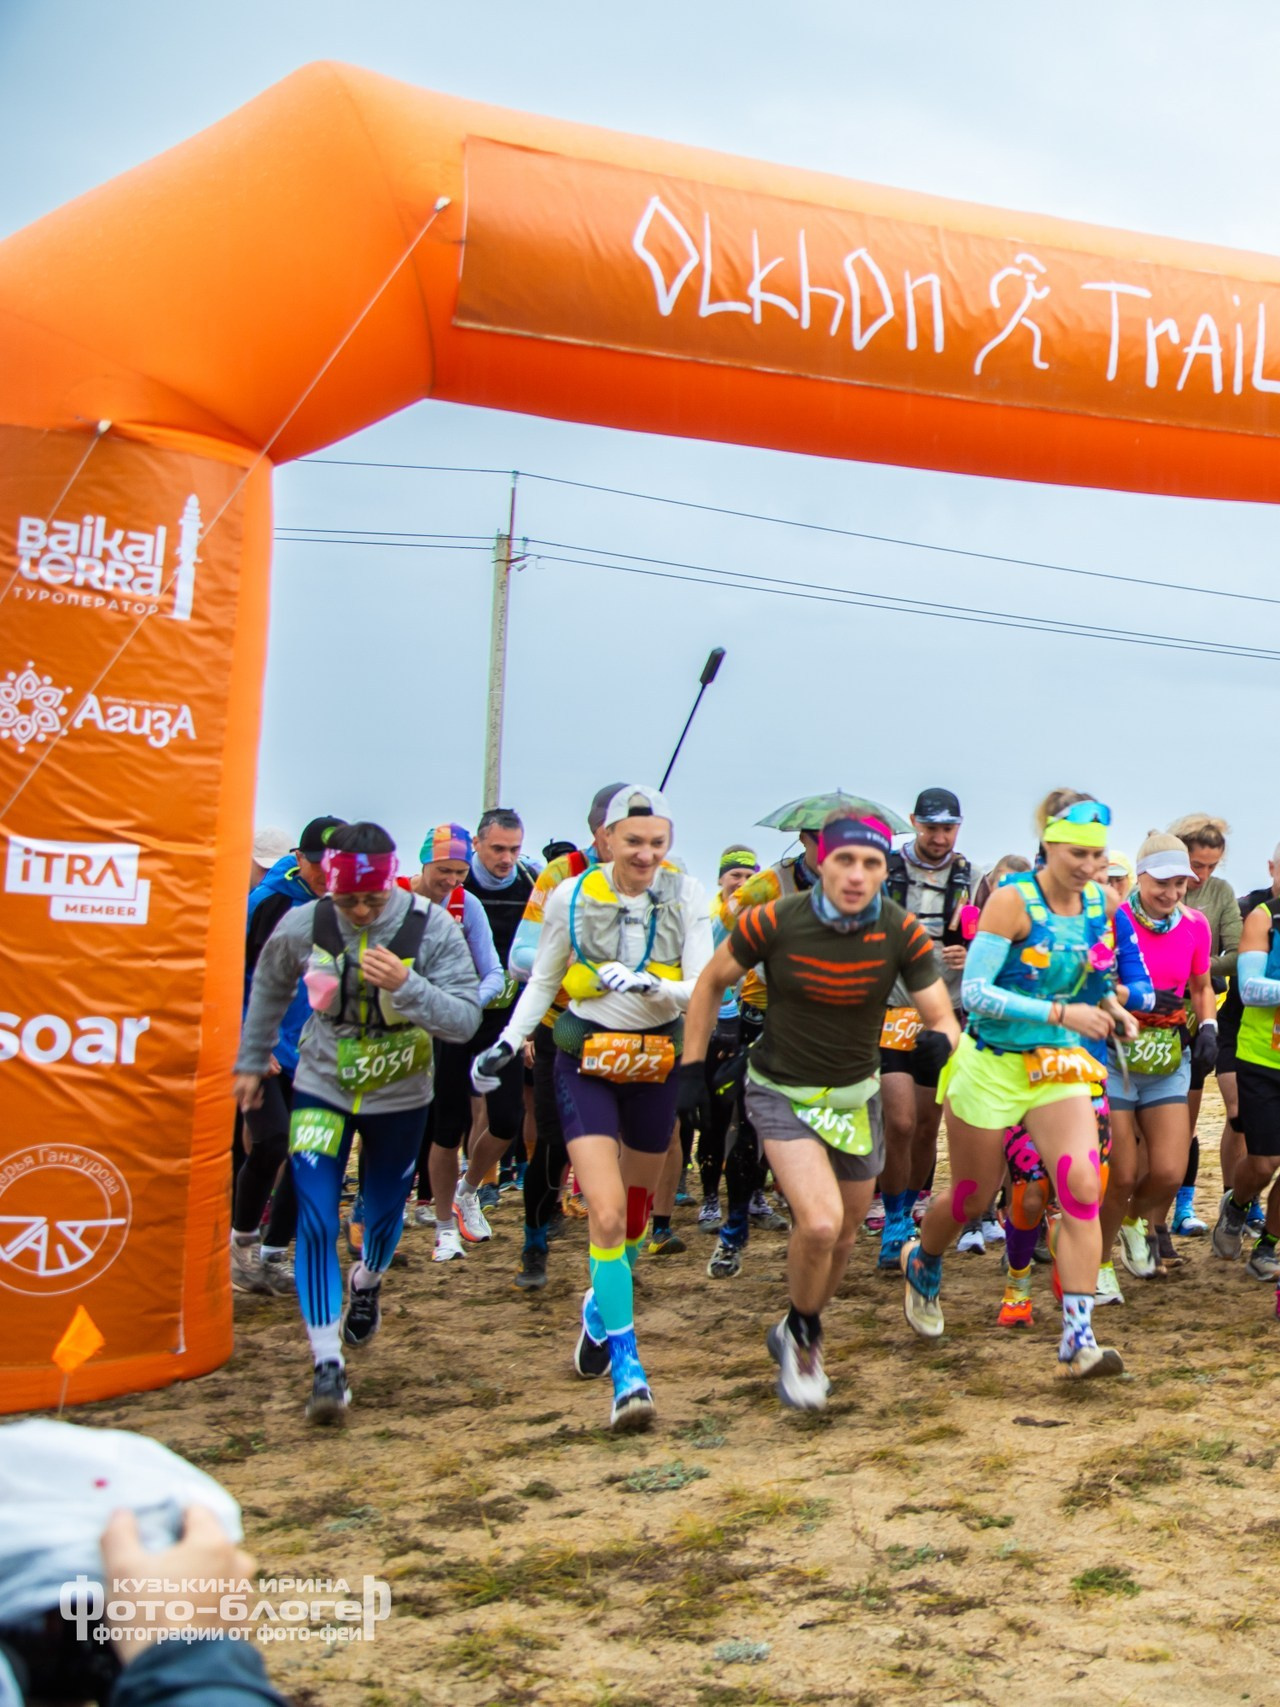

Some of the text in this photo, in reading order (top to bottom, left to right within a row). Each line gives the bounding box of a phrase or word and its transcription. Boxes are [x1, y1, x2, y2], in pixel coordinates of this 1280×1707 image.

[13, 586, 159, 615] ТУРОПЕРАТОР
[64, 903, 137, 917] MEMBER
[0, 1011, 150, 1065] soar
[355, 1044, 416, 1084] 3039
[598, 1049, 663, 1077] 5023
[1131, 1039, 1173, 1067] 3033
[0, 1147, 121, 1196] арья Ганжурова
